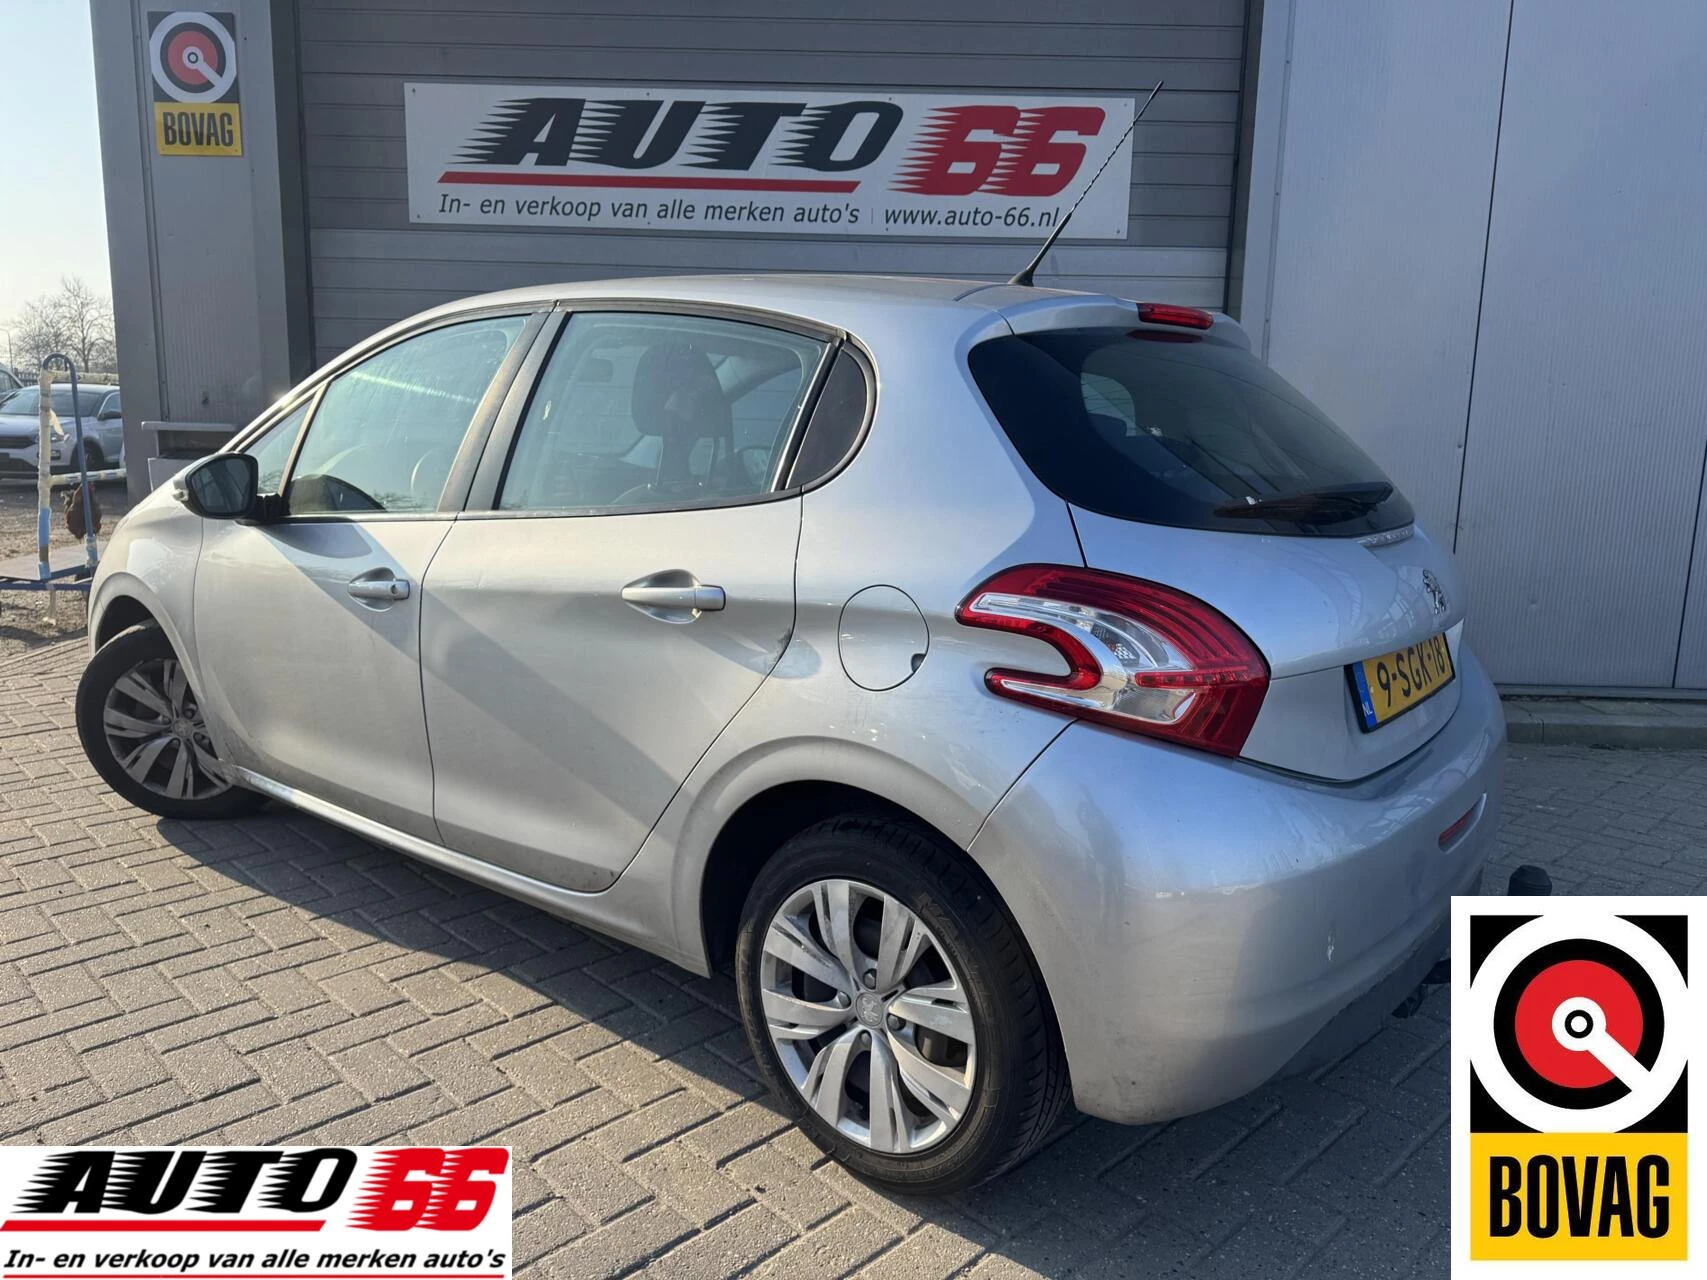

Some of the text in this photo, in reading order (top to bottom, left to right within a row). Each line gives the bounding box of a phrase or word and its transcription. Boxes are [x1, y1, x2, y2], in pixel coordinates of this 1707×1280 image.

[163, 111, 234, 147] BOVAG
[445, 97, 1106, 197] AUTO 66
[439, 193, 1060, 228] In- en verkoop van alle merken auto's www.auto-66.nl
[1376, 636, 1446, 708] 9-SGK-18
[1362, 701, 1373, 716] NL
